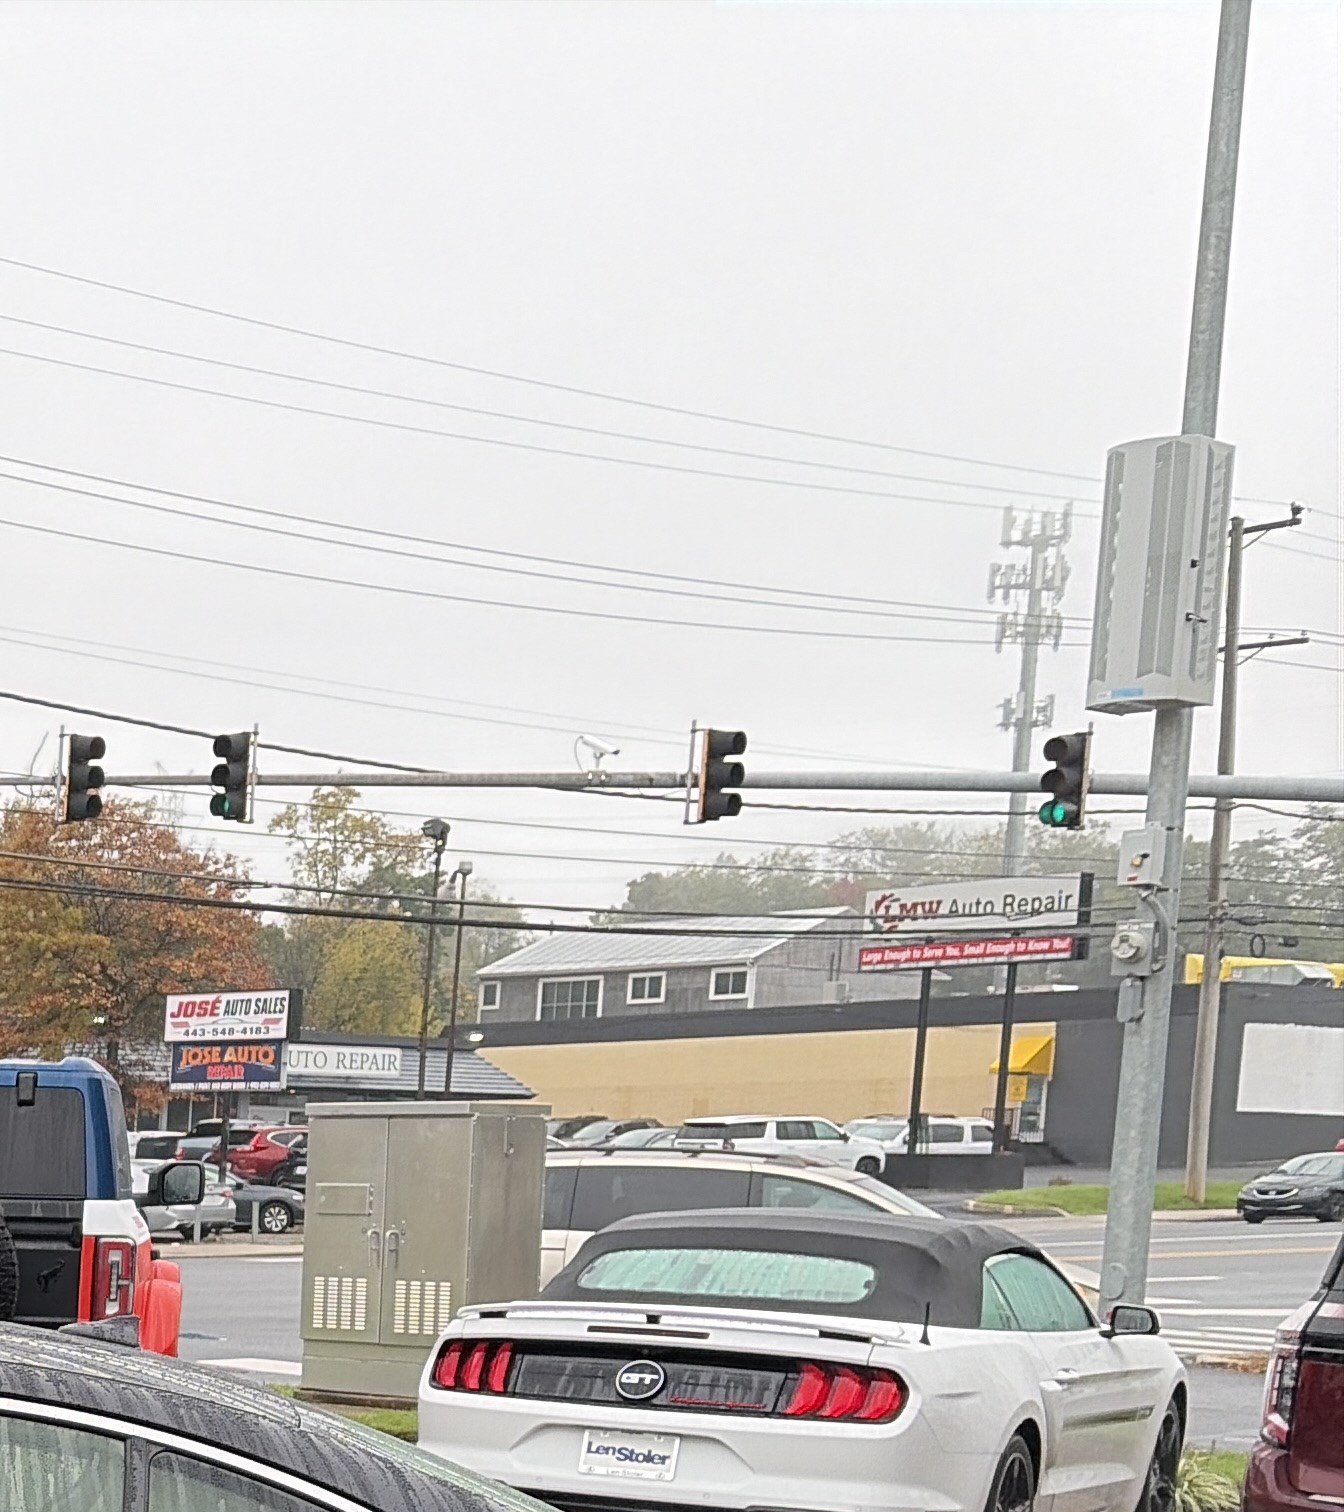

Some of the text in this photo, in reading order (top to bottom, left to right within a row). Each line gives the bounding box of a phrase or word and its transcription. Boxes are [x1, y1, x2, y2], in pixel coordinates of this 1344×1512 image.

[949, 897, 994, 915] Auto
[1003, 889, 1073, 918] Repair
[863, 951, 883, 964] Large
[884, 948, 912, 962] Enough
[922, 946, 945, 958] Serve
[963, 942, 986, 956] Small
[986, 940, 1016, 955] Enough
[1027, 939, 1051, 951] Know
[170, 994, 287, 1019] JOSÉ AUTO SALES
[182, 1026, 270, 1037] 443-548-4183
[180, 1045, 275, 1068] JOSE AUTO
[288, 1050, 399, 1072] UTO REPAIR
[621, 1373, 660, 1386] GT
